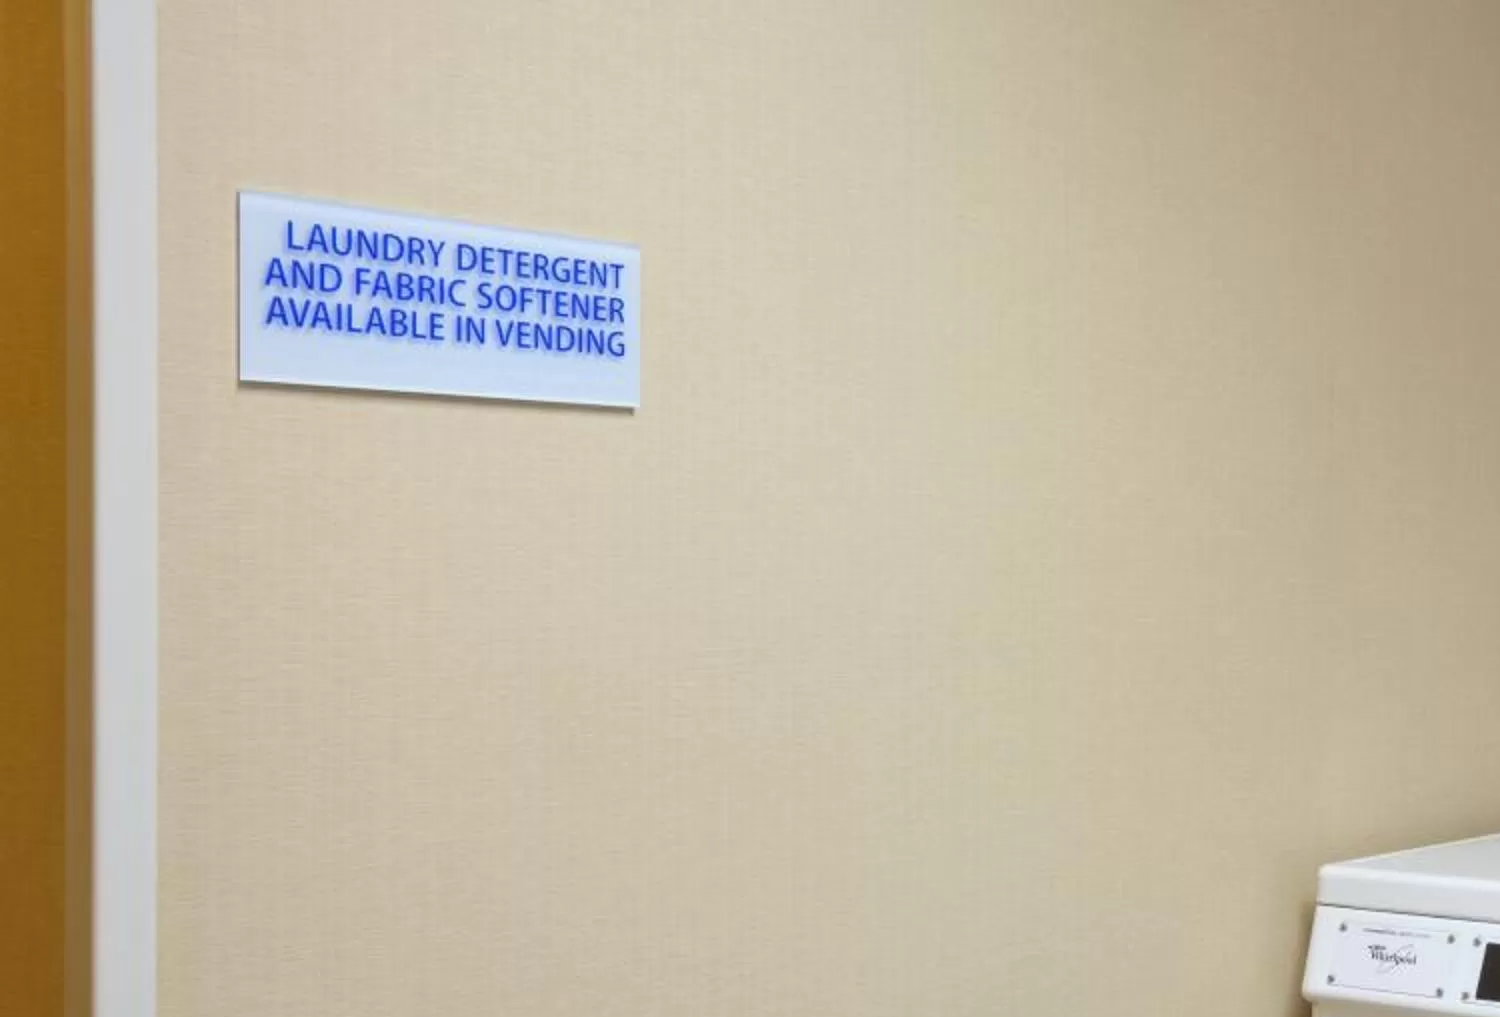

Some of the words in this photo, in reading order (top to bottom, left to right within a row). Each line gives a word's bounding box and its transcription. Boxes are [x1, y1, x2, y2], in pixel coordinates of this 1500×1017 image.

[286, 220, 445, 267] LAUNDRY
[456, 243, 624, 289] DETERGENT
[263, 257, 343, 293] AND
[354, 266, 466, 307] FABRIC
[476, 281, 624, 323] SOFTENER
[264, 295, 444, 341] AVAILABLE
[455, 314, 485, 344] IN
[494, 319, 624, 357] VENDING
